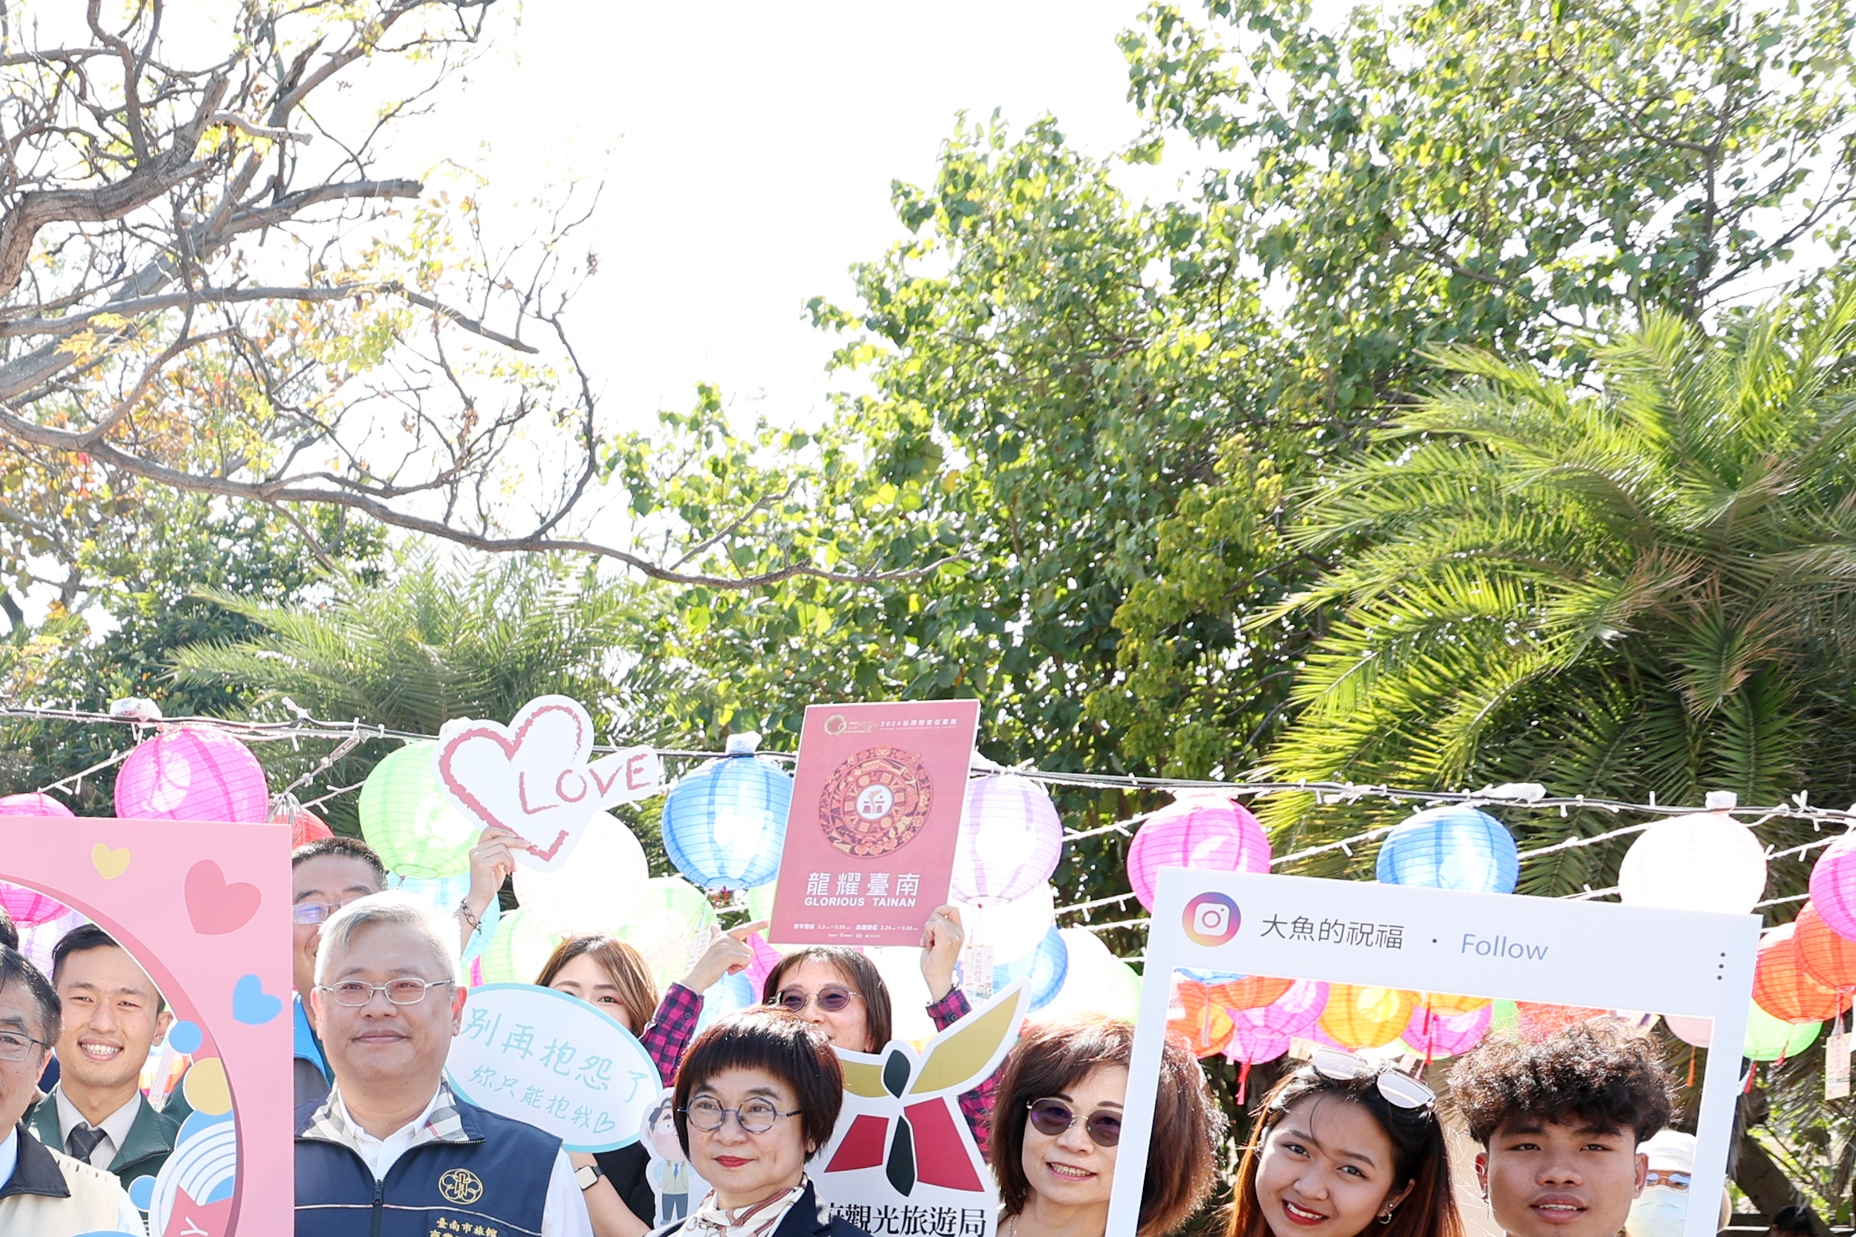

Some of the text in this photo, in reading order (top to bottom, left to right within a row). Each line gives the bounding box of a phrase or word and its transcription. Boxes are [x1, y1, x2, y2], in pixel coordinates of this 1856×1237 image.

[518, 752, 652, 815] LOVE
[804, 897, 917, 908] GLORIOUS TAINAN
[806, 871, 921, 897] 龍耀臺南
[1259, 913, 1549, 961] 大魚的祝福 Follow
[461, 1007, 649, 1103] 別再抱怨了
